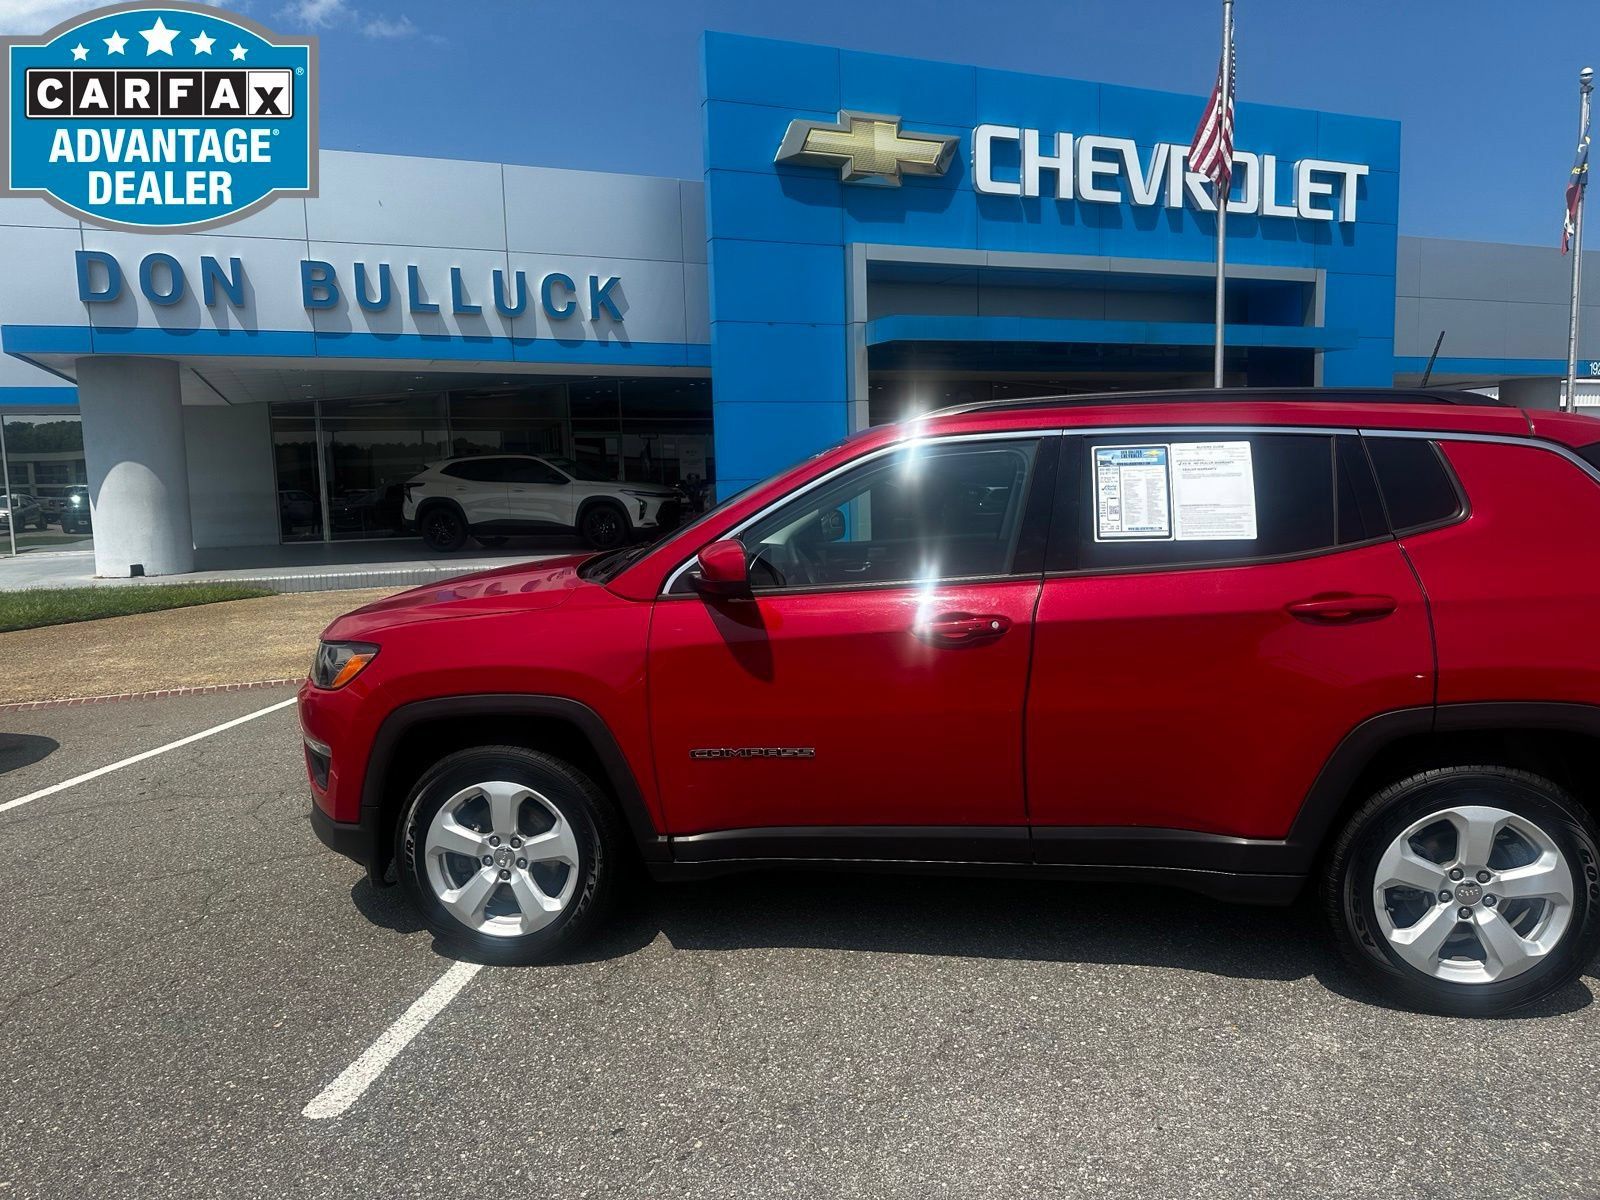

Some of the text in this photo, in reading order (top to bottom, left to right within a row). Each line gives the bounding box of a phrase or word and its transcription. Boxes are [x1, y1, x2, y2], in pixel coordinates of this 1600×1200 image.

[971, 123, 1369, 223] CHEVROLET
[75, 250, 625, 322] DON BULLUCK
[689, 747, 816, 759] COMPASS
